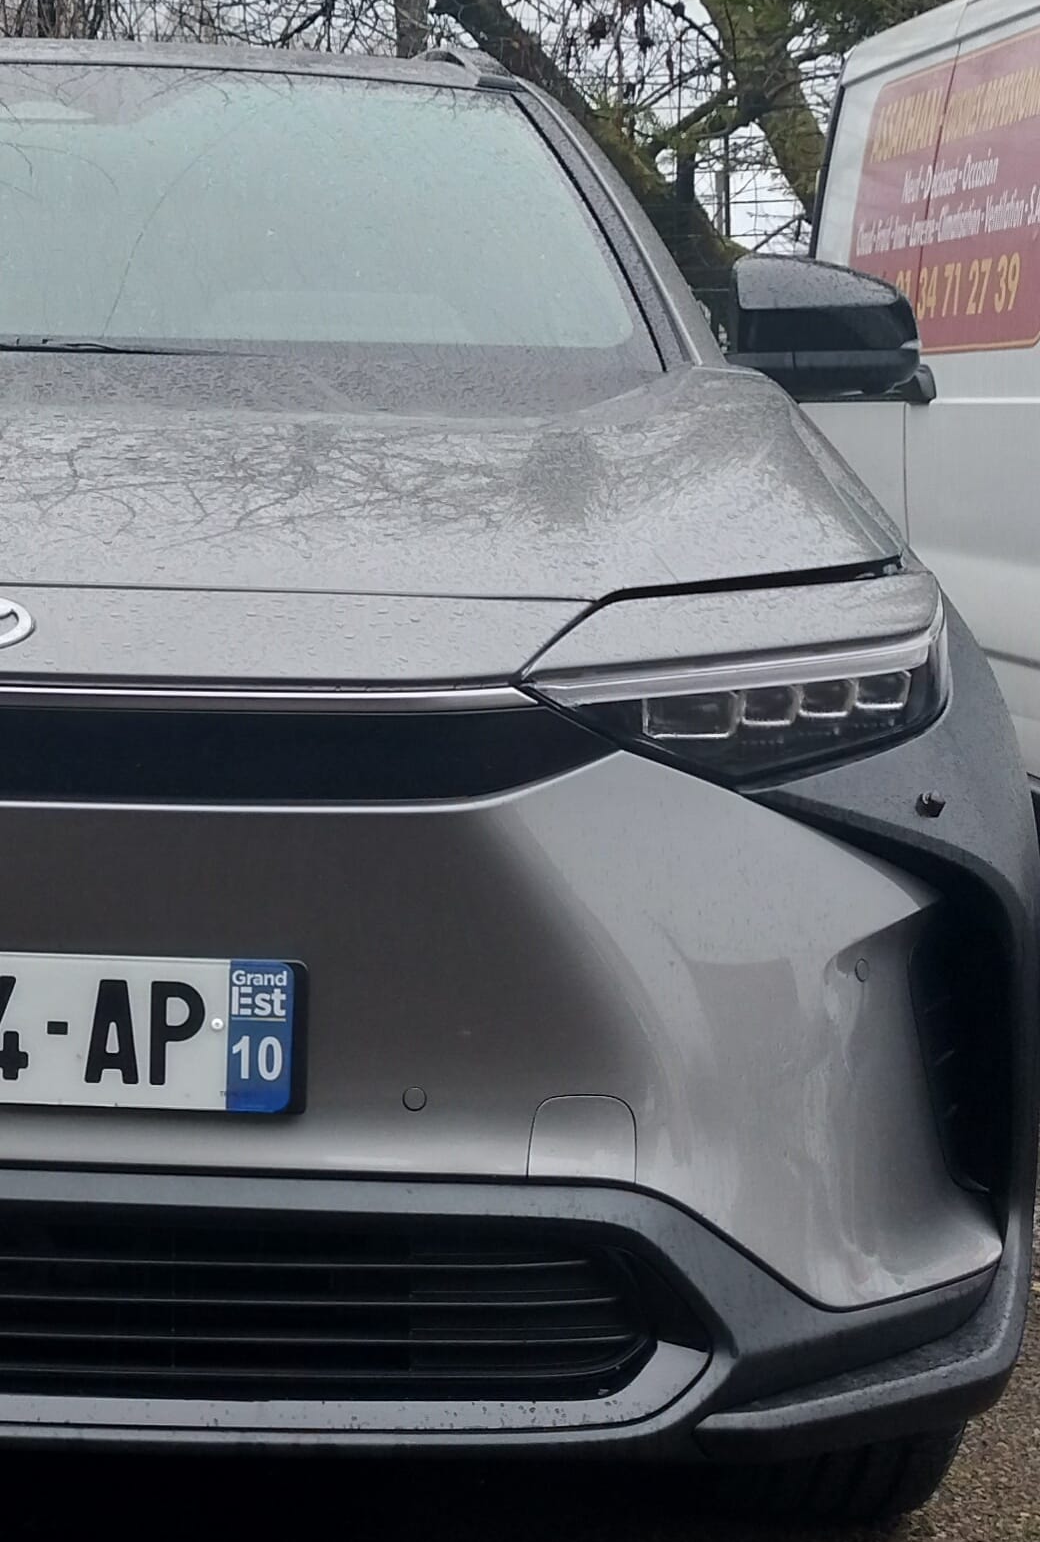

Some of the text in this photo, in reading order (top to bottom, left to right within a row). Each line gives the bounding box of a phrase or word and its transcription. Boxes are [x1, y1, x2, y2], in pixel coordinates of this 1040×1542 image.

[962, 147, 999, 192] Occasion
[984, 188, 1024, 234] Ventilation
[917, 266, 939, 321] 34
[942, 261, 962, 318] 71
[966, 258, 993, 315] 27
[994, 251, 1021, 313] 39
[231, 969, 288, 987] Grand
[231, 986, 287, 1017] Est
[231, 1034, 283, 1081] 10
